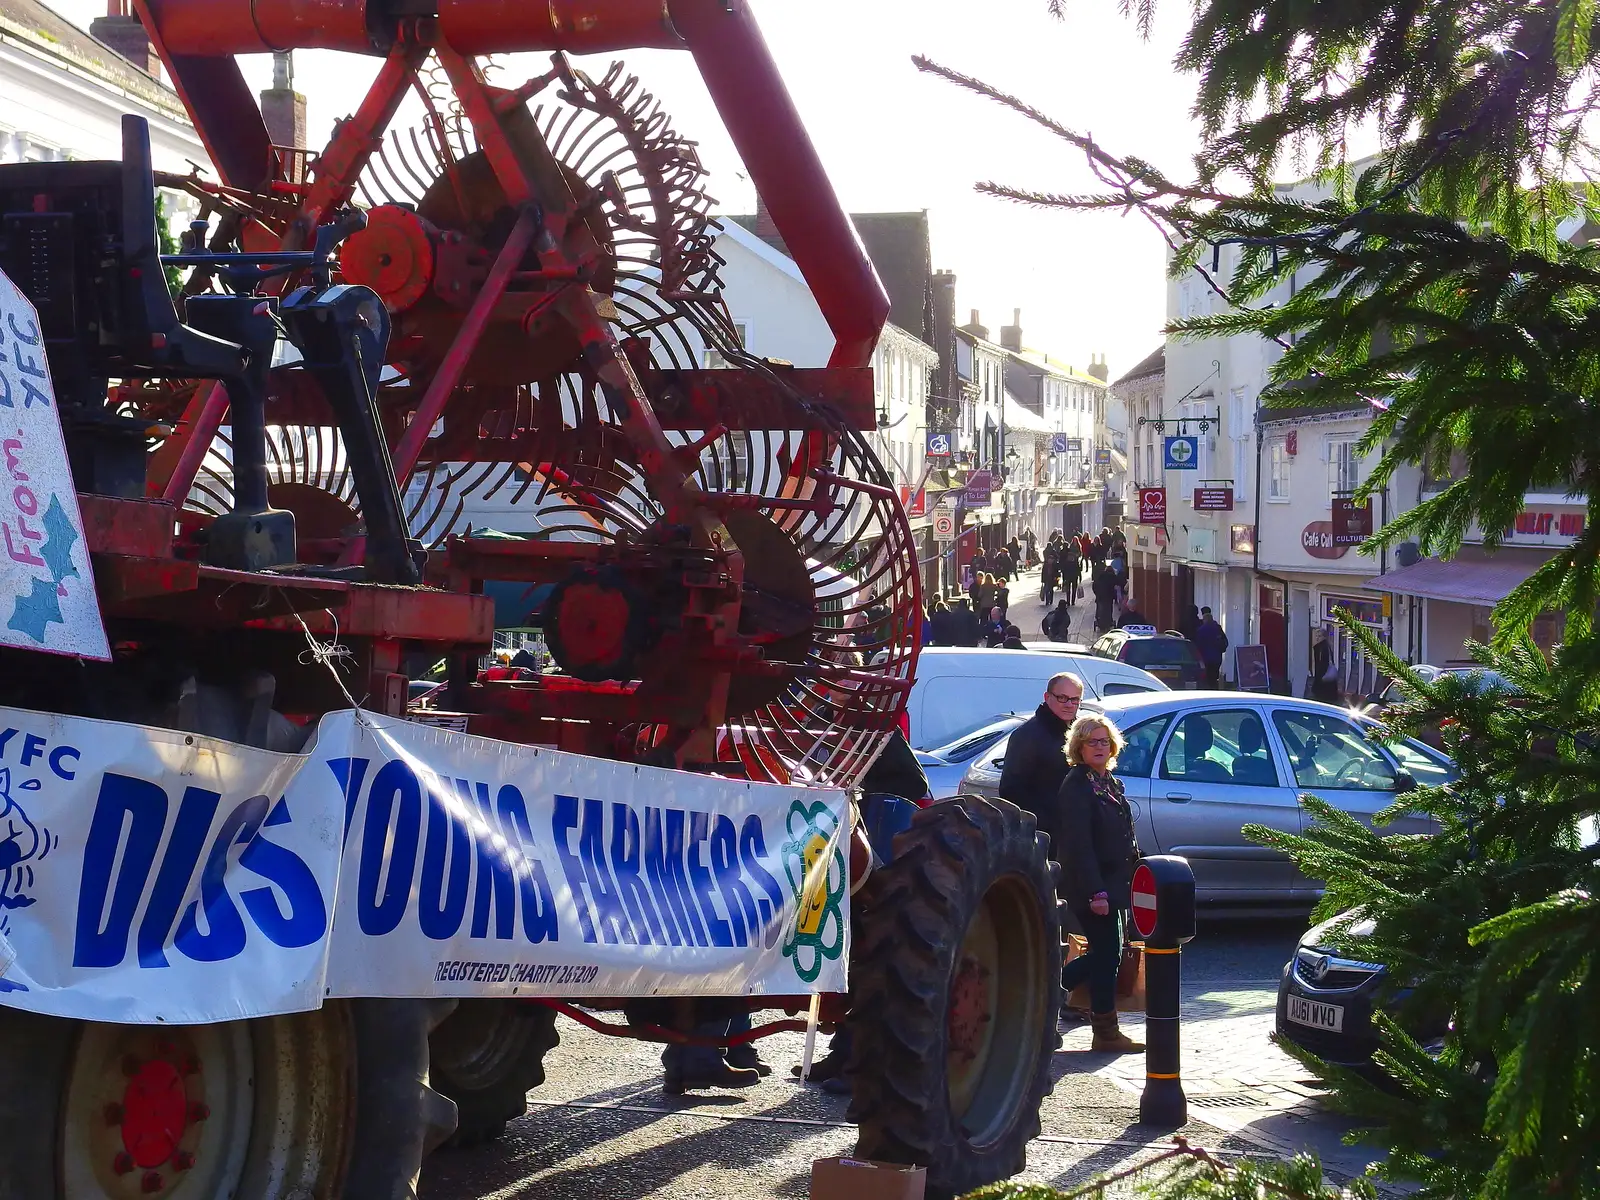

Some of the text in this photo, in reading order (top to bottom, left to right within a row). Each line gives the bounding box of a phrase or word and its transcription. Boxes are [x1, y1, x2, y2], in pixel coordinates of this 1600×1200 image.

[1303, 531, 1319, 547] Café
[72, 757, 786, 968] DISS YOUNG FARMERS
[434, 961, 599, 984] REGISTERED CHARITY 265209
